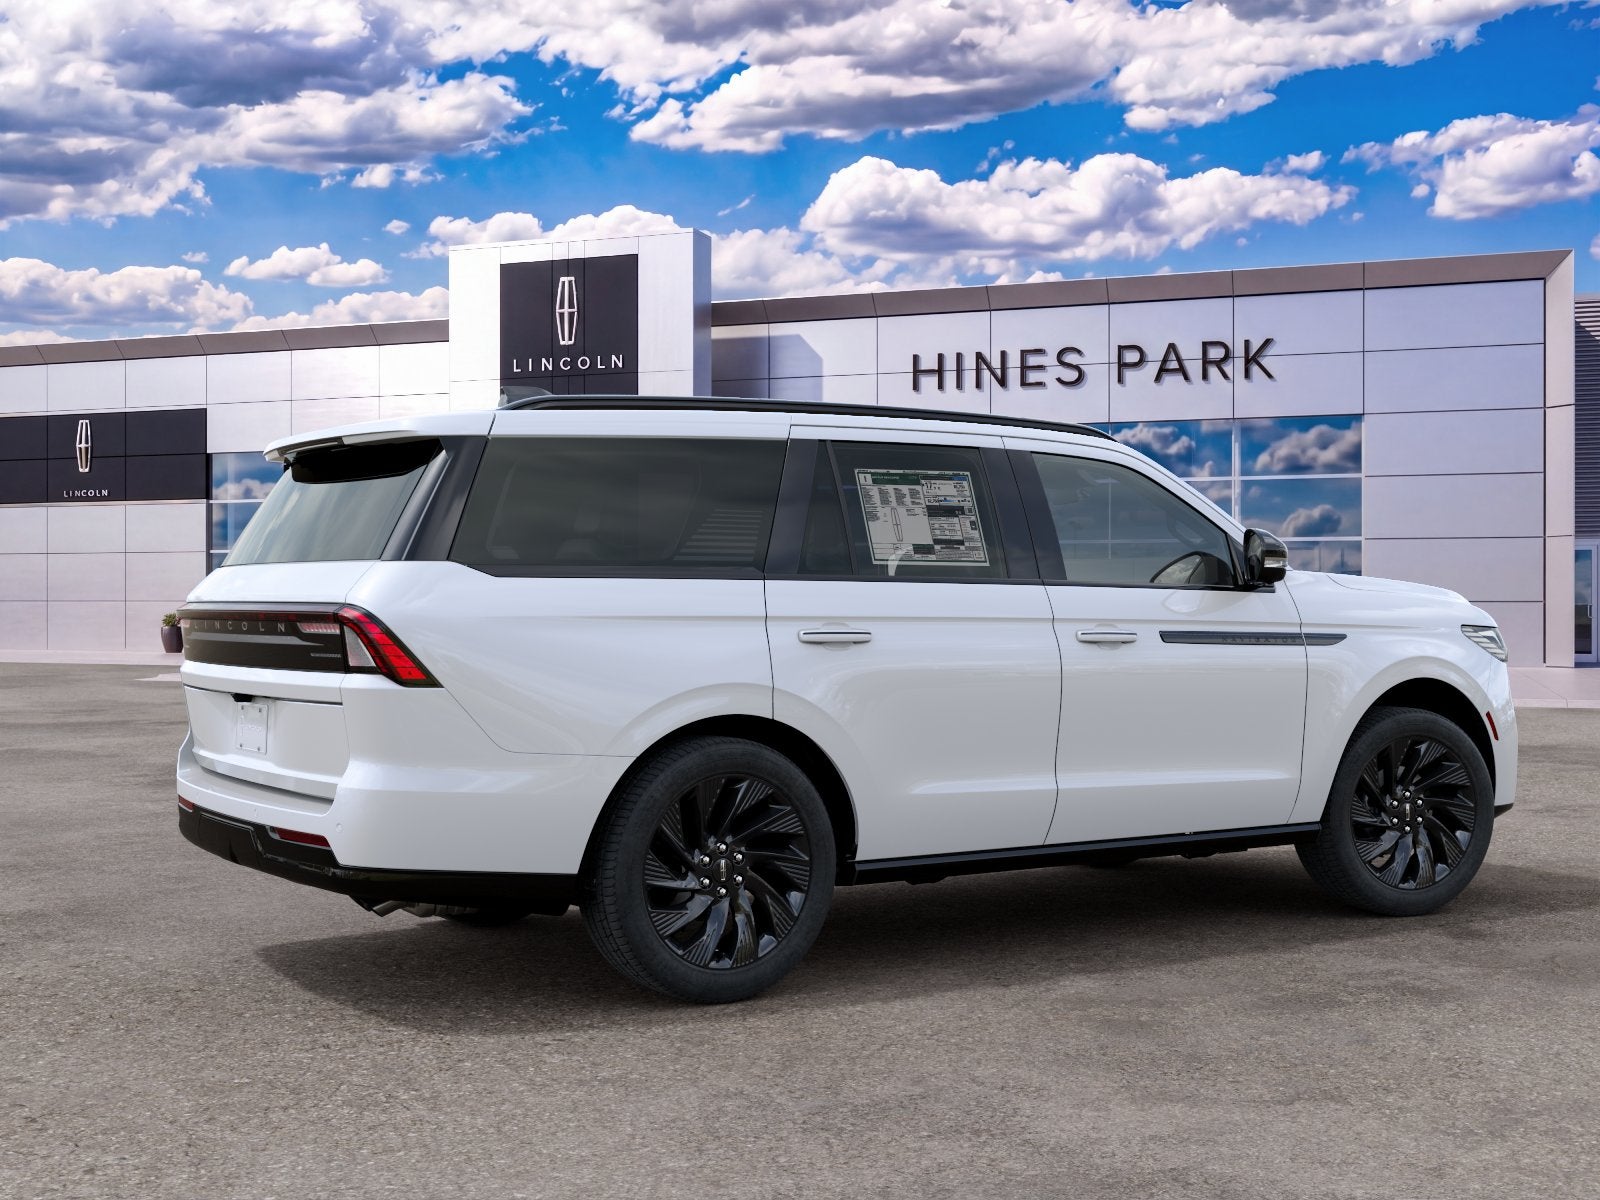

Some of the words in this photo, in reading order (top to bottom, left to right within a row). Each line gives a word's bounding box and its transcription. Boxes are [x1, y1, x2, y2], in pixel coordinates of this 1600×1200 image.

[513, 354, 623, 372] LINCOLN
[912, 346, 1085, 392] HINES
[1117, 338, 1276, 385] PARK
[63, 489, 108, 498] LINCOLN
[194, 621, 285, 632] LINCOLN
